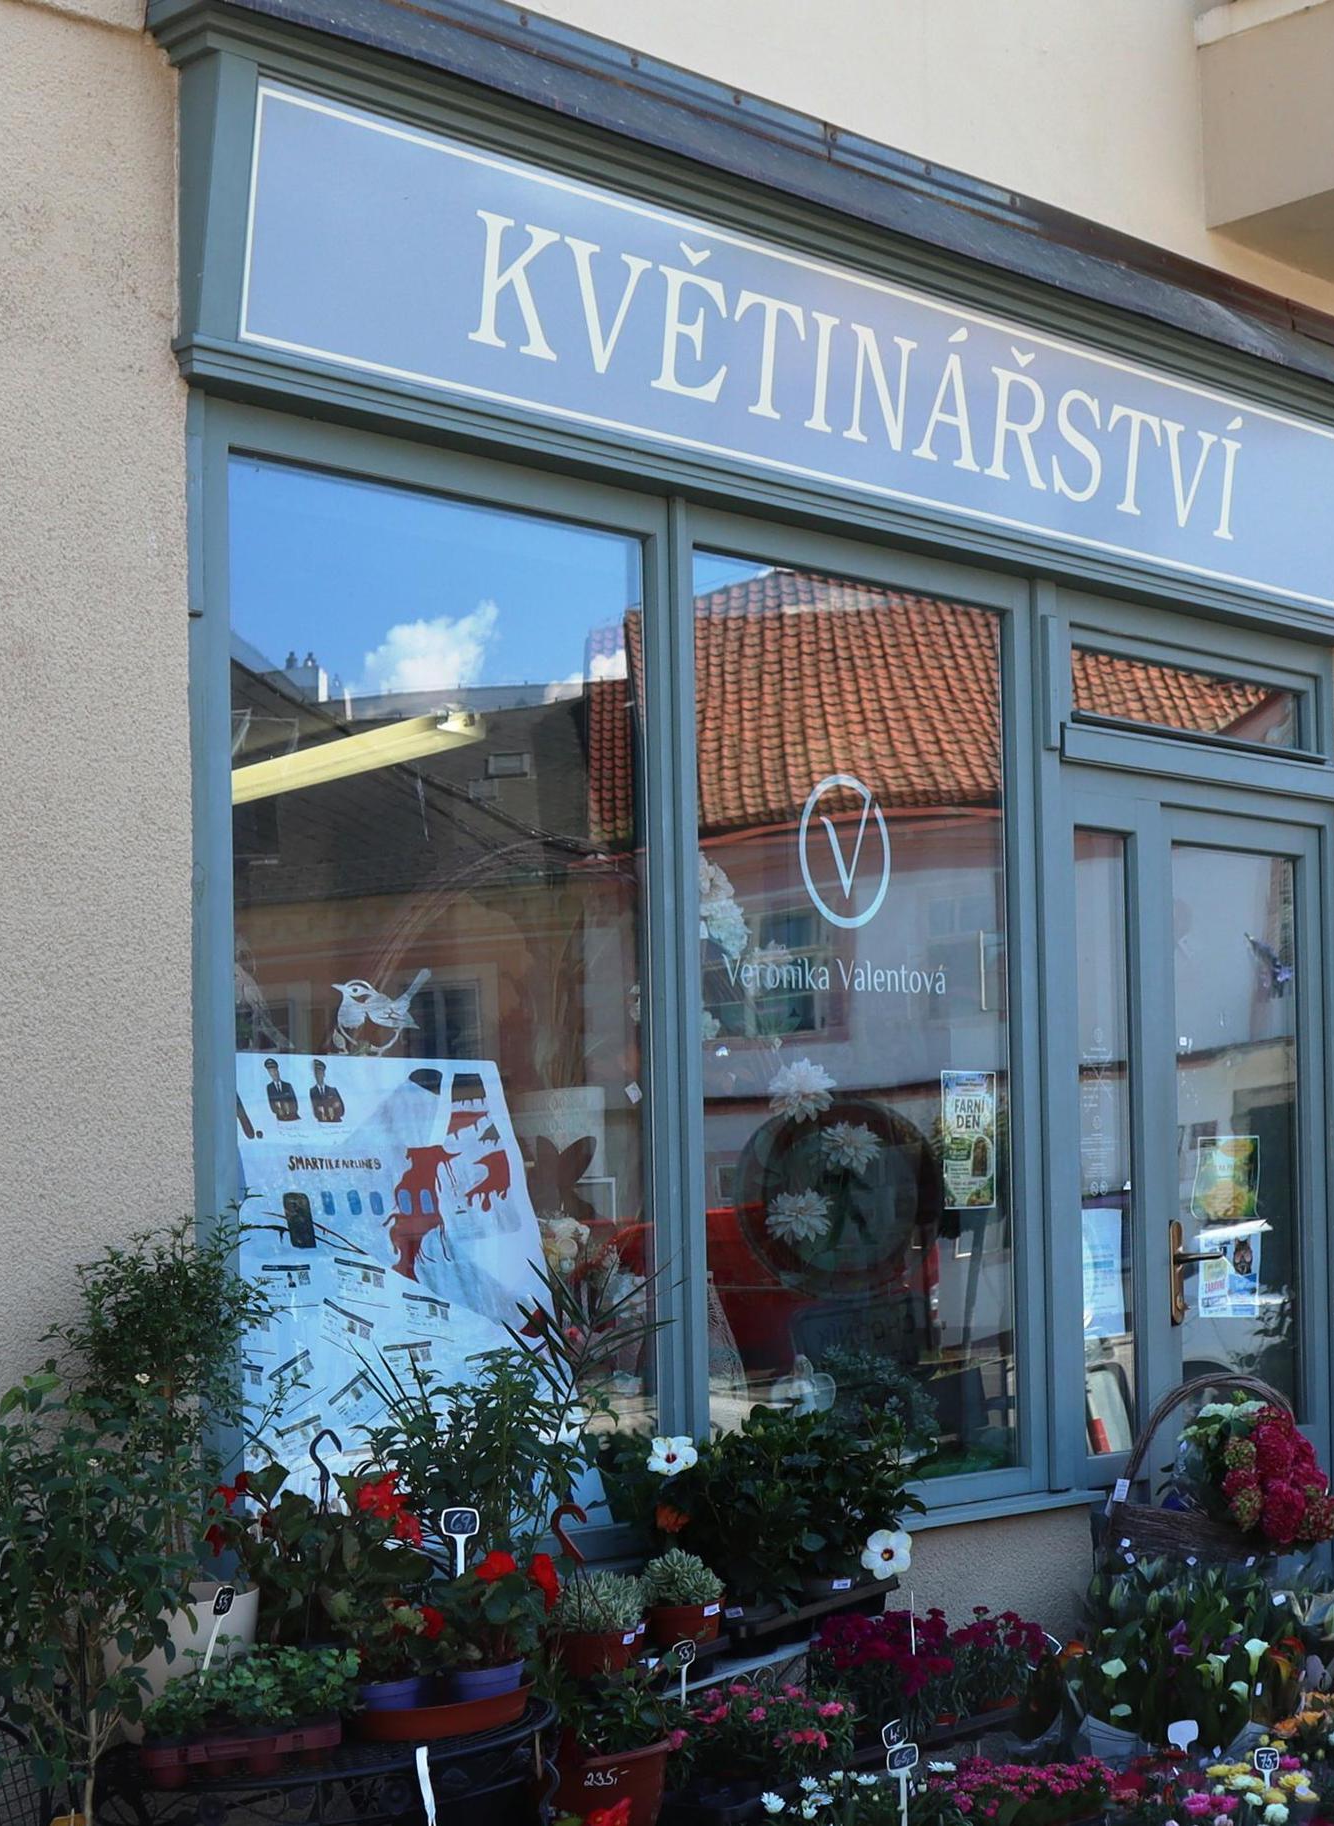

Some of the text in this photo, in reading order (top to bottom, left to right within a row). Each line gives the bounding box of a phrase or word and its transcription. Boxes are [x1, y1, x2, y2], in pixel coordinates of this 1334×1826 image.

[468, 207, 1243, 542] KVĚTINÁŘSTVÍ
[722, 953, 947, 995] Veronika Valentová
[954, 1096, 985, 1113] FARNÍ
[956, 1115, 981, 1129] DEN
